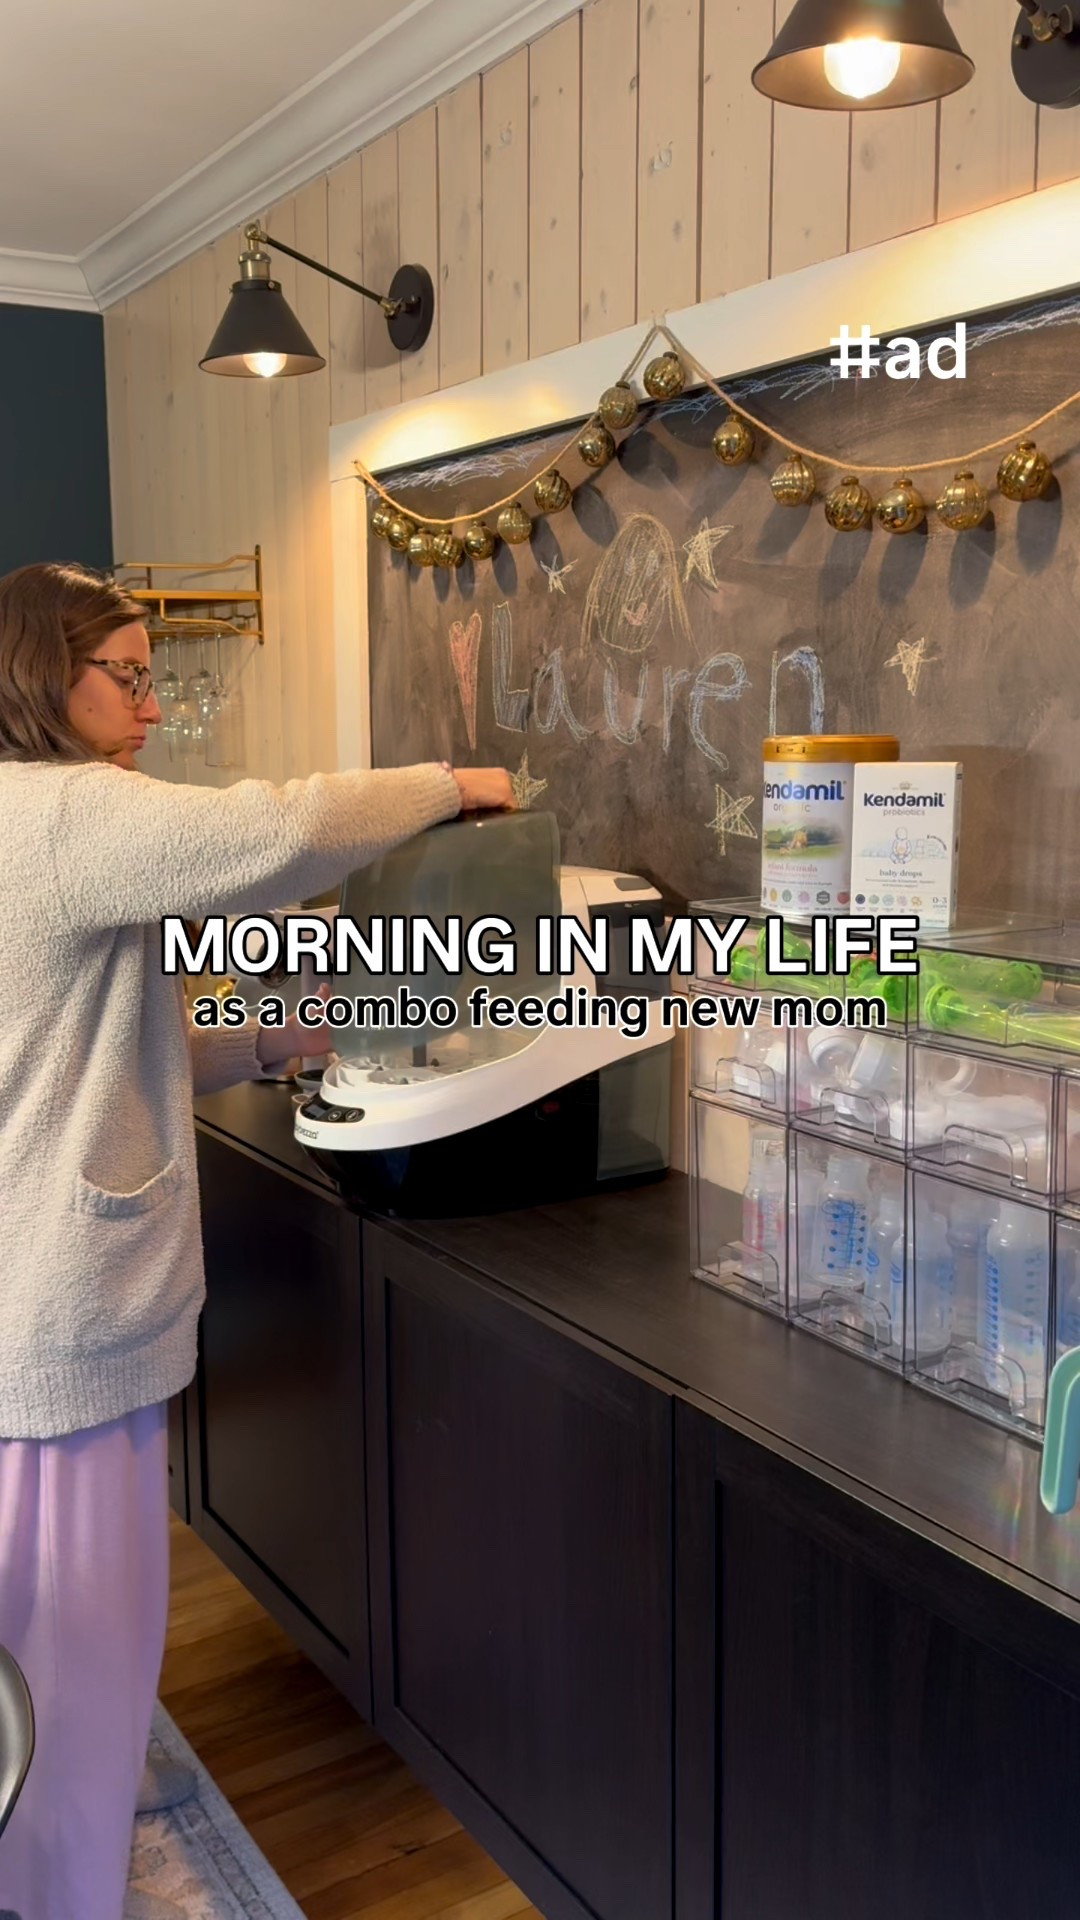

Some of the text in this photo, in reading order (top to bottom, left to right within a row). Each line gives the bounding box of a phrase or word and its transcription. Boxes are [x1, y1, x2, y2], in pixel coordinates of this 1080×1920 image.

[492, 600, 825, 771] Lauren
[864, 792, 945, 808] Kendamil
[882, 808, 926, 817] probiotics
[879, 869, 923, 879] baby drops
